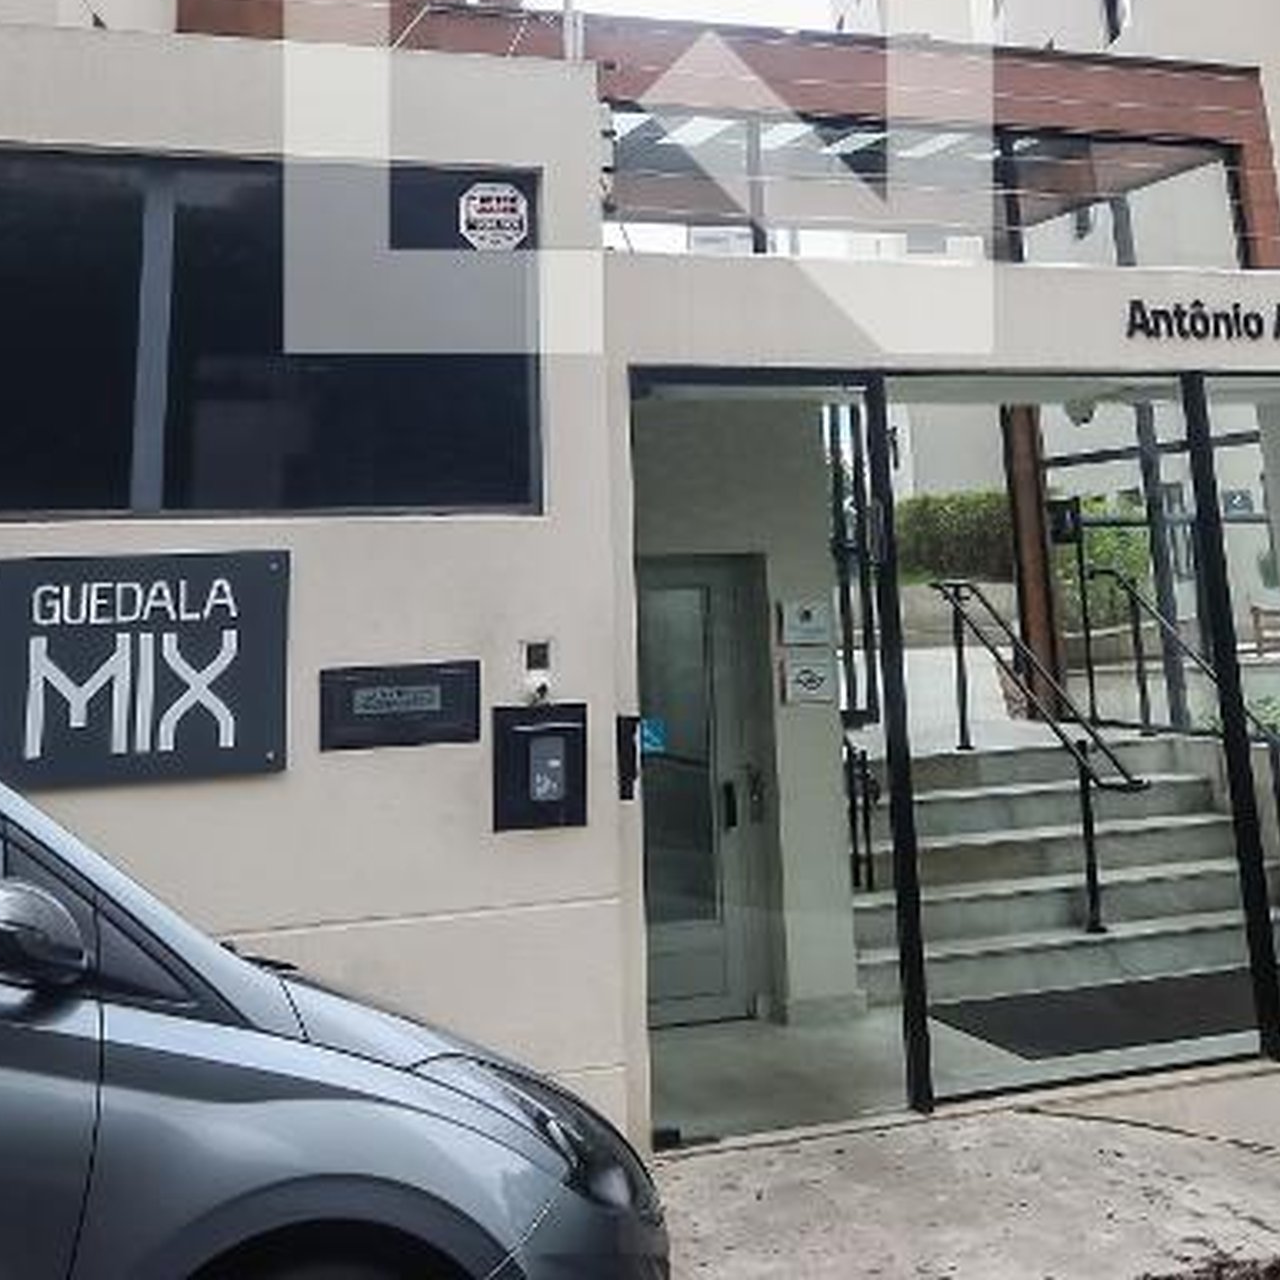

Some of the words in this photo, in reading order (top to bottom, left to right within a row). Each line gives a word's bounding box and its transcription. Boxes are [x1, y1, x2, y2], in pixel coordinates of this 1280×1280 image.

[1126, 299, 1264, 340] Antônio
[31, 578, 238, 625] GUEDALA
[24, 629, 239, 760] MIX
